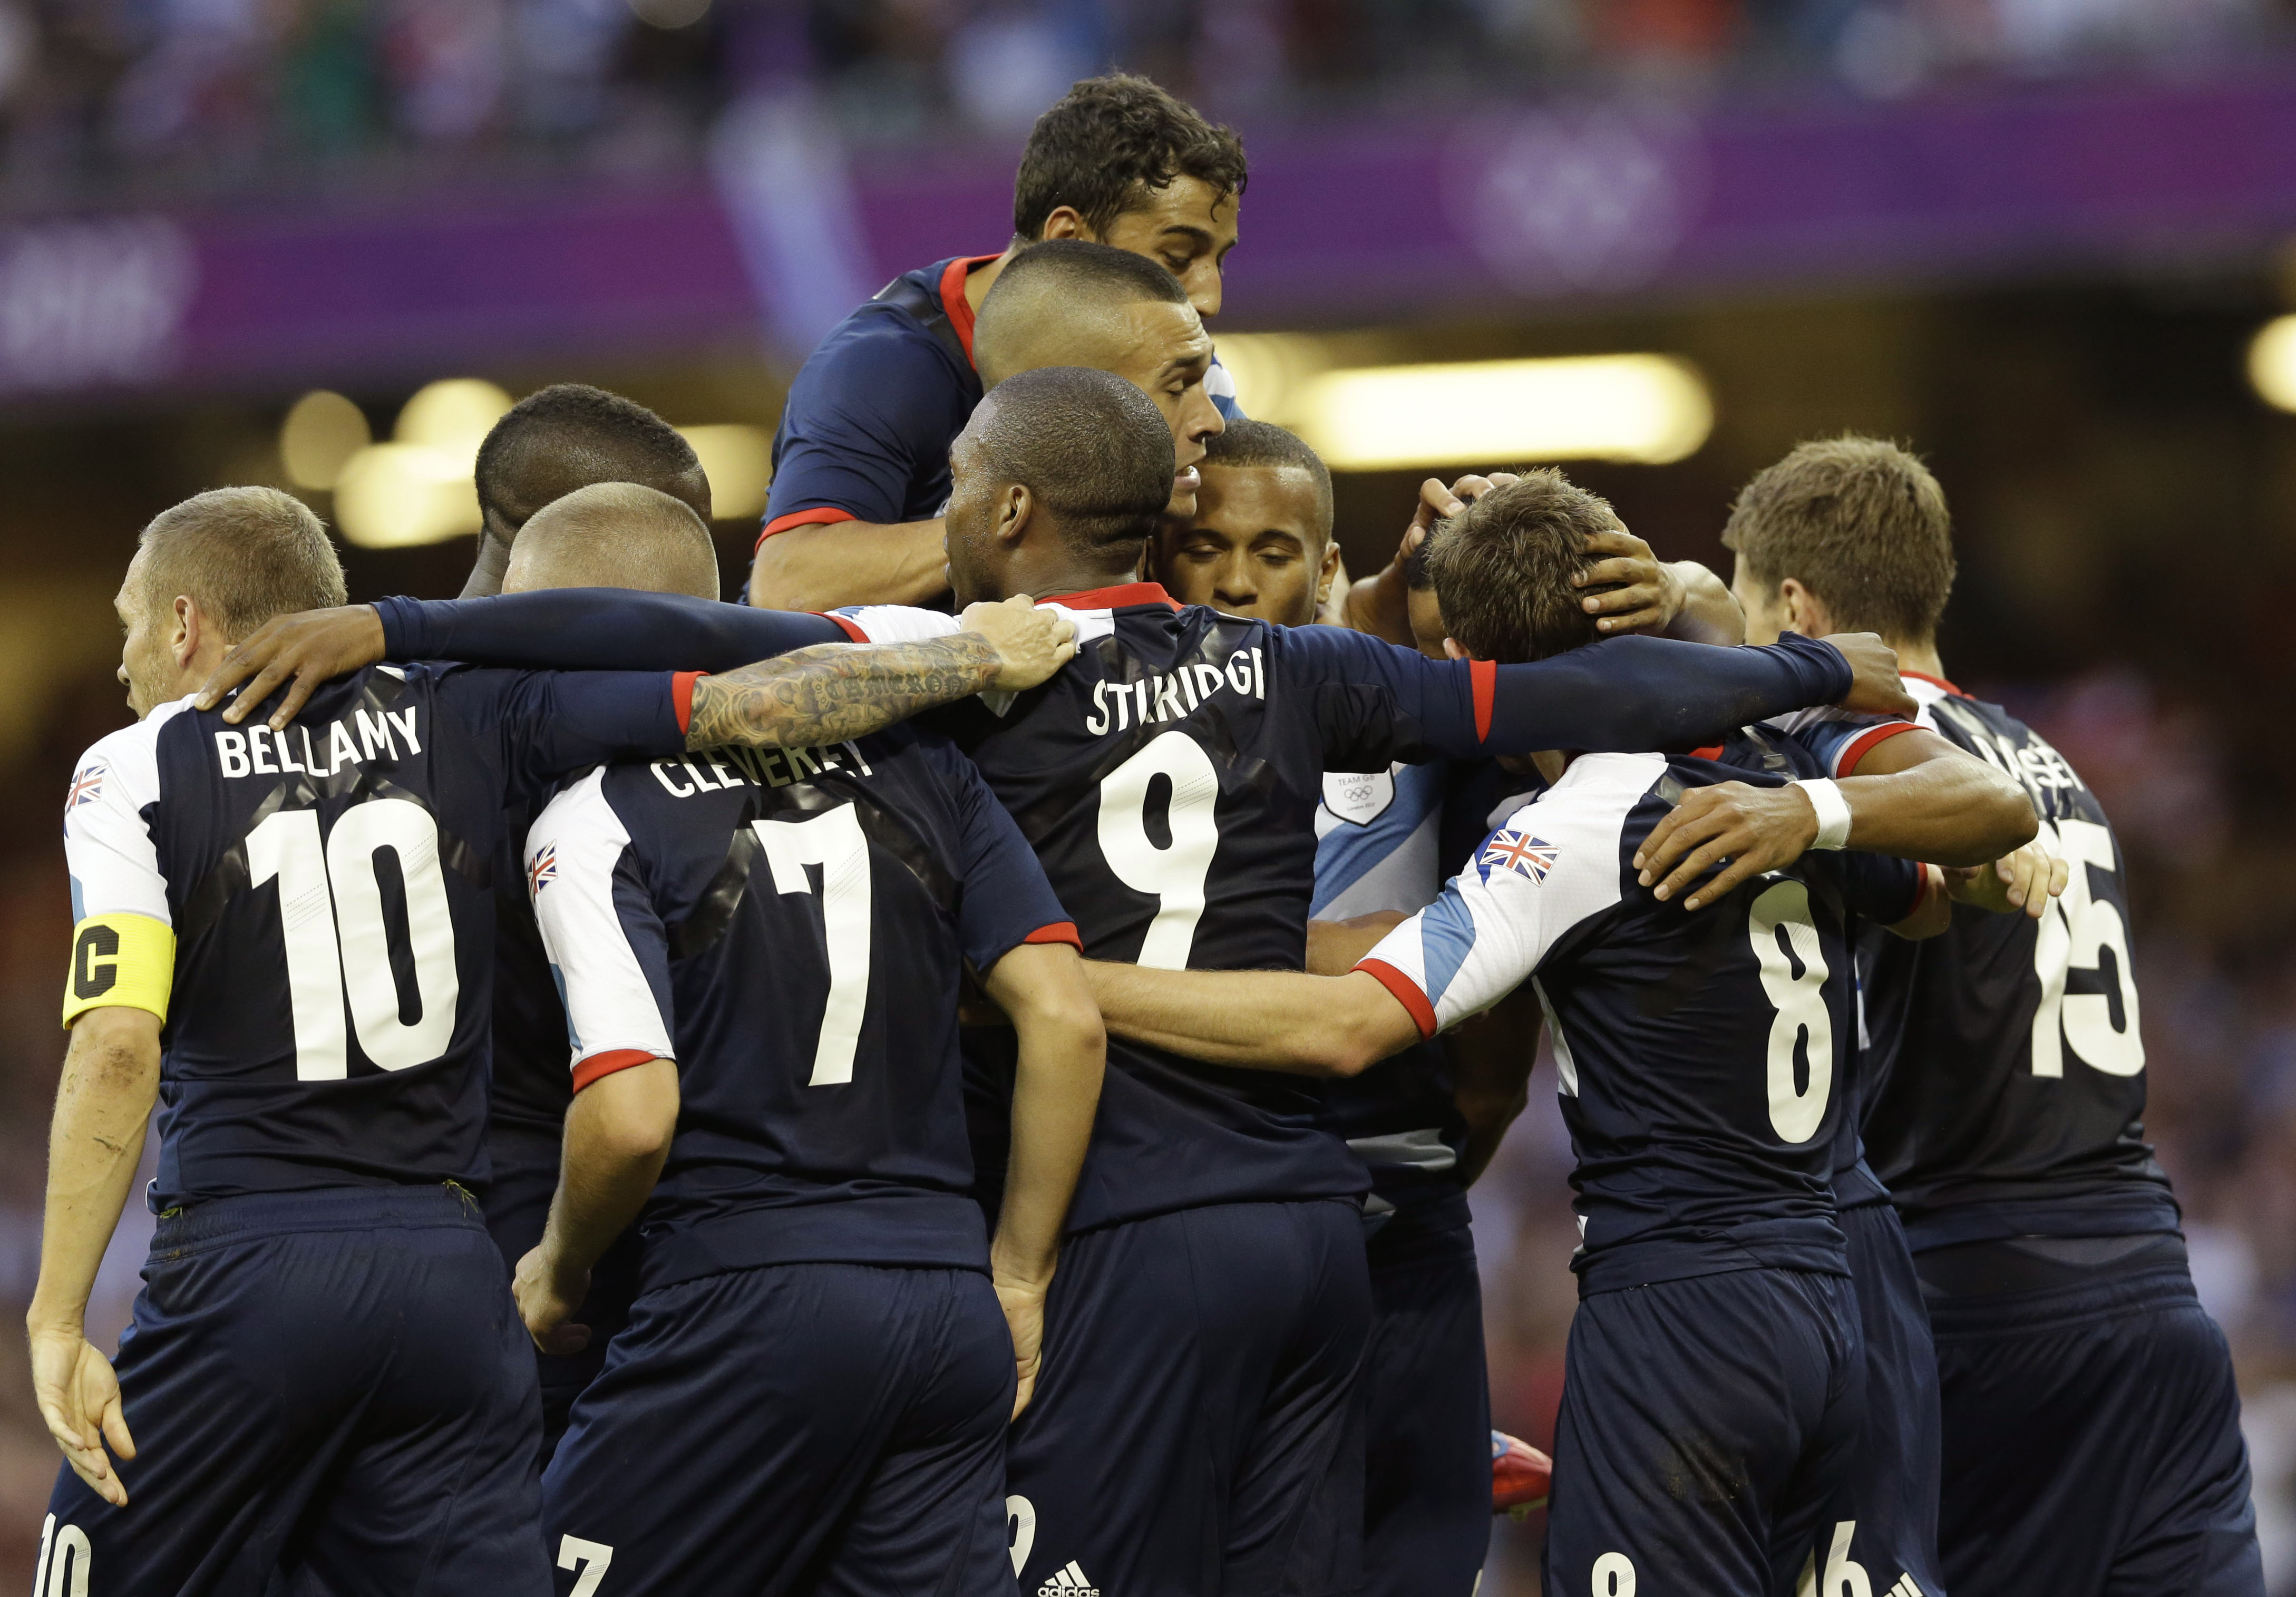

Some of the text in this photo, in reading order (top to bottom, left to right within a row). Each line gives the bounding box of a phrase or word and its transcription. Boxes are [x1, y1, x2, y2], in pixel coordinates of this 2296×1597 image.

[215, 706, 422, 778] BELLAMY
[1338, 775, 1360, 786] TEAM
[1097, 731, 1219, 971] 9
[74, 924, 119, 1000] C
[245, 798, 459, 1081] 10
[751, 802, 871, 1086] 7
[2031, 817, 2146, 1078] 15
[1749, 880, 1833, 1143] 8
[34, 1512, 91, 1597] 10
[557, 1534, 614, 1597] 7
[1037, 1586, 1100, 1597] adidas
